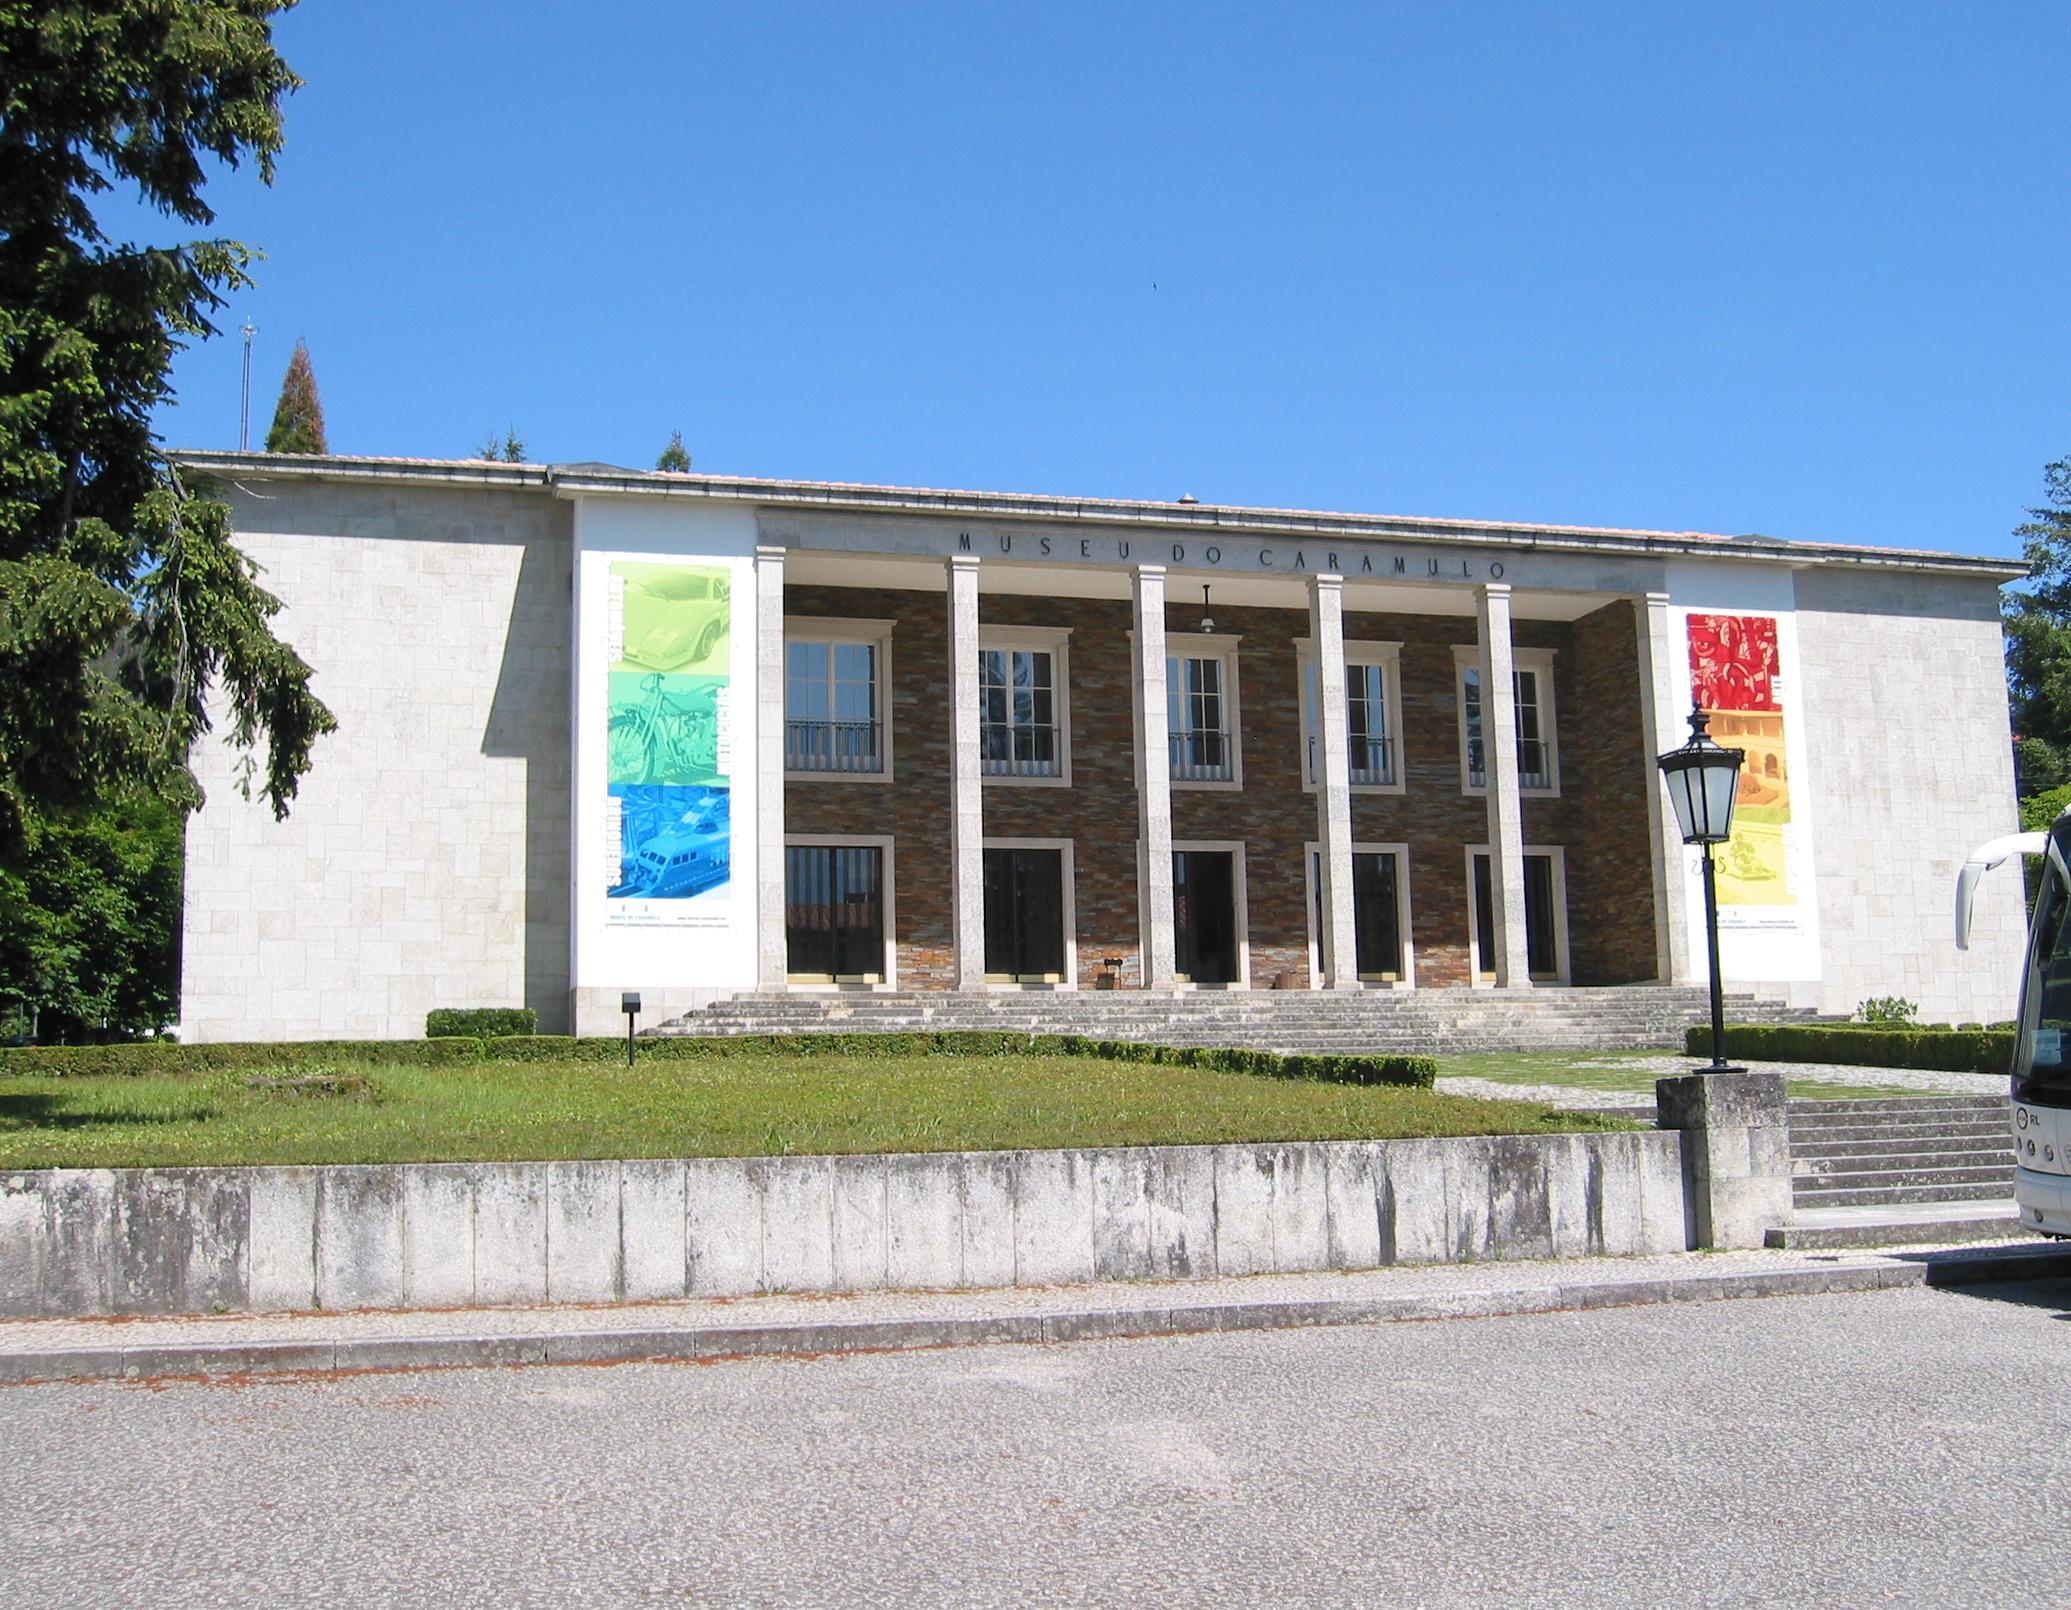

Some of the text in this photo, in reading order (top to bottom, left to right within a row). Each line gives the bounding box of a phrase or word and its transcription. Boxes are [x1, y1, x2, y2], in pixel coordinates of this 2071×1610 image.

[958, 532, 1505, 579] MUSEU DO CARAMULO
